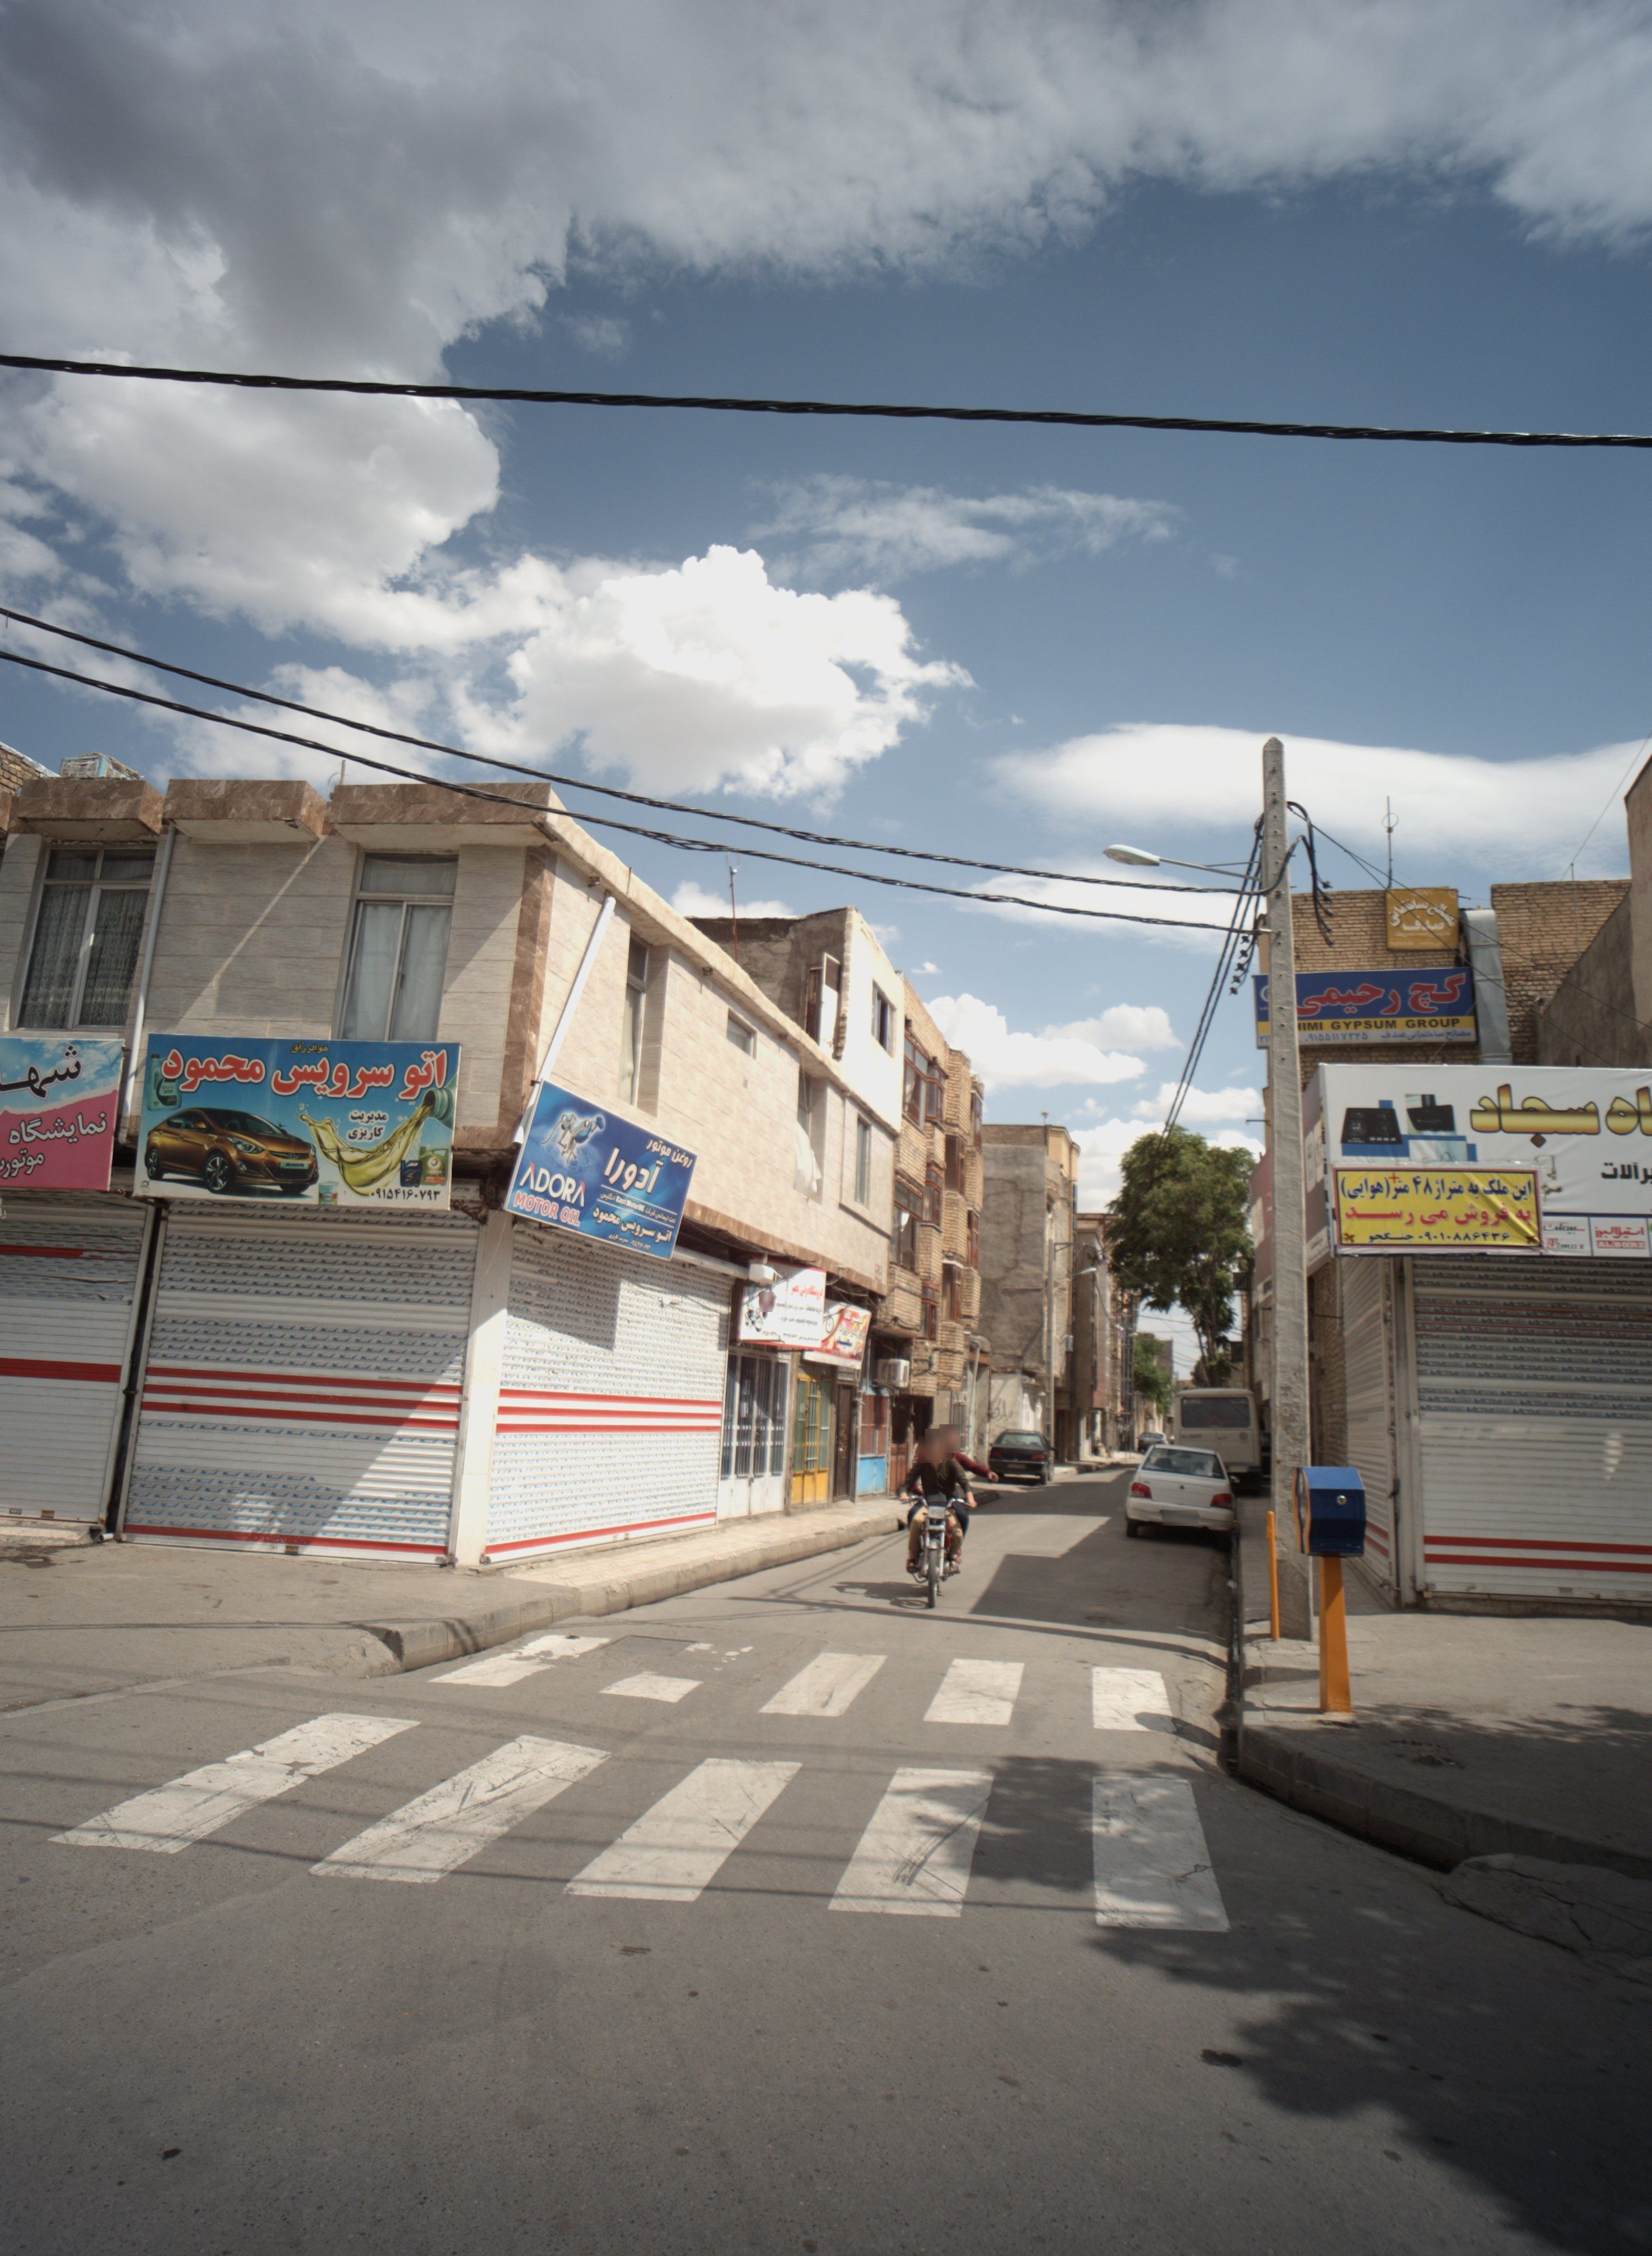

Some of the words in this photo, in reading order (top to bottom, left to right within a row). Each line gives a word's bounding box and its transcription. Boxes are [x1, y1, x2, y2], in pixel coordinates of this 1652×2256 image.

[1297, 983, 1401, 1017] رحیمی
[1408, 972, 1466, 1014] گچ
[1297, 1022, 1323, 1031] HIMI
[1331, 1019, 1397, 1030] GYPSUM
[1405, 1018, 1460, 1028] GROUP
[161, 1049, 265, 1092] محمود
[271, 1057, 394, 1098] سرویس
[399, 1049, 447, 1099] اتو
[350, 1111, 387, 1124] مدیریت
[1470, 1083, 1601, 1148] سجاد
[9, 1113, 107, 1144] نمایشگاه
[348, 1127, 383, 1140] کاریزی
[646, 1140, 672, 1157] موتور
[671, 1149, 693, 1168] روغن
[605, 1147, 664, 1194] آدورا
[520, 1162, 585, 1207] ADORA
[1414, 1176, 1433, 1195] ۴۸
[1435, 1178, 1463, 1200] متراژ
[1468, 1181, 1480, 1198] به
[1482, 1178, 1508, 1196] ملک
[1513, 1179, 1532, 1201] این
[371, 1188, 441, 1201] ۰۹۱۵۴۱۶۰۷۹۳
[513, 1190, 559, 1219] MOTOR
[560, 1206, 580, 1227] OIL
[593, 1207, 621, 1224] محمود
[1345, 1206, 1414, 1225] رسد
[1420, 1208, 1448, 1226] می
[1454, 1202, 1509, 1227] فروش
[1515, 1207, 1531, 1225] به
[621, 1221, 655, 1237] سرویس
[655, 1229, 672, 1243] اتو
